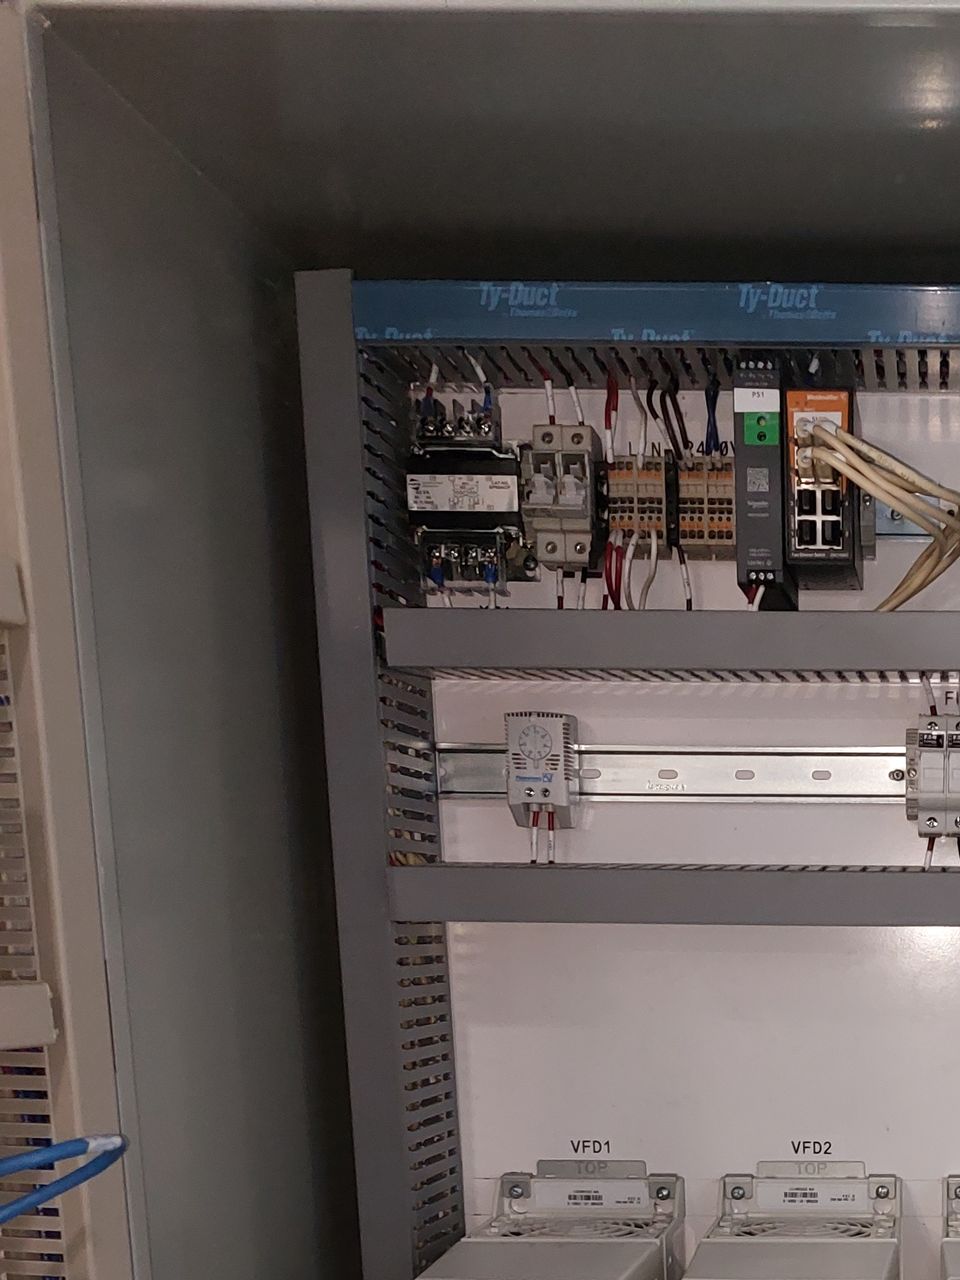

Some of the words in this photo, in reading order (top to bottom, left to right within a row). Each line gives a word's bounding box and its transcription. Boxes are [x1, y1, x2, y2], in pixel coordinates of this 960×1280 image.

[479, 281, 559, 312] Ty-Duct
[737, 283, 819, 313] Ty-Duct
[651, 442, 661, 458] N
[570, 1139, 611, 1154] VFD1
[791, 1140, 833, 1156] VFD2
[795, 1162, 828, 1176] TOP
